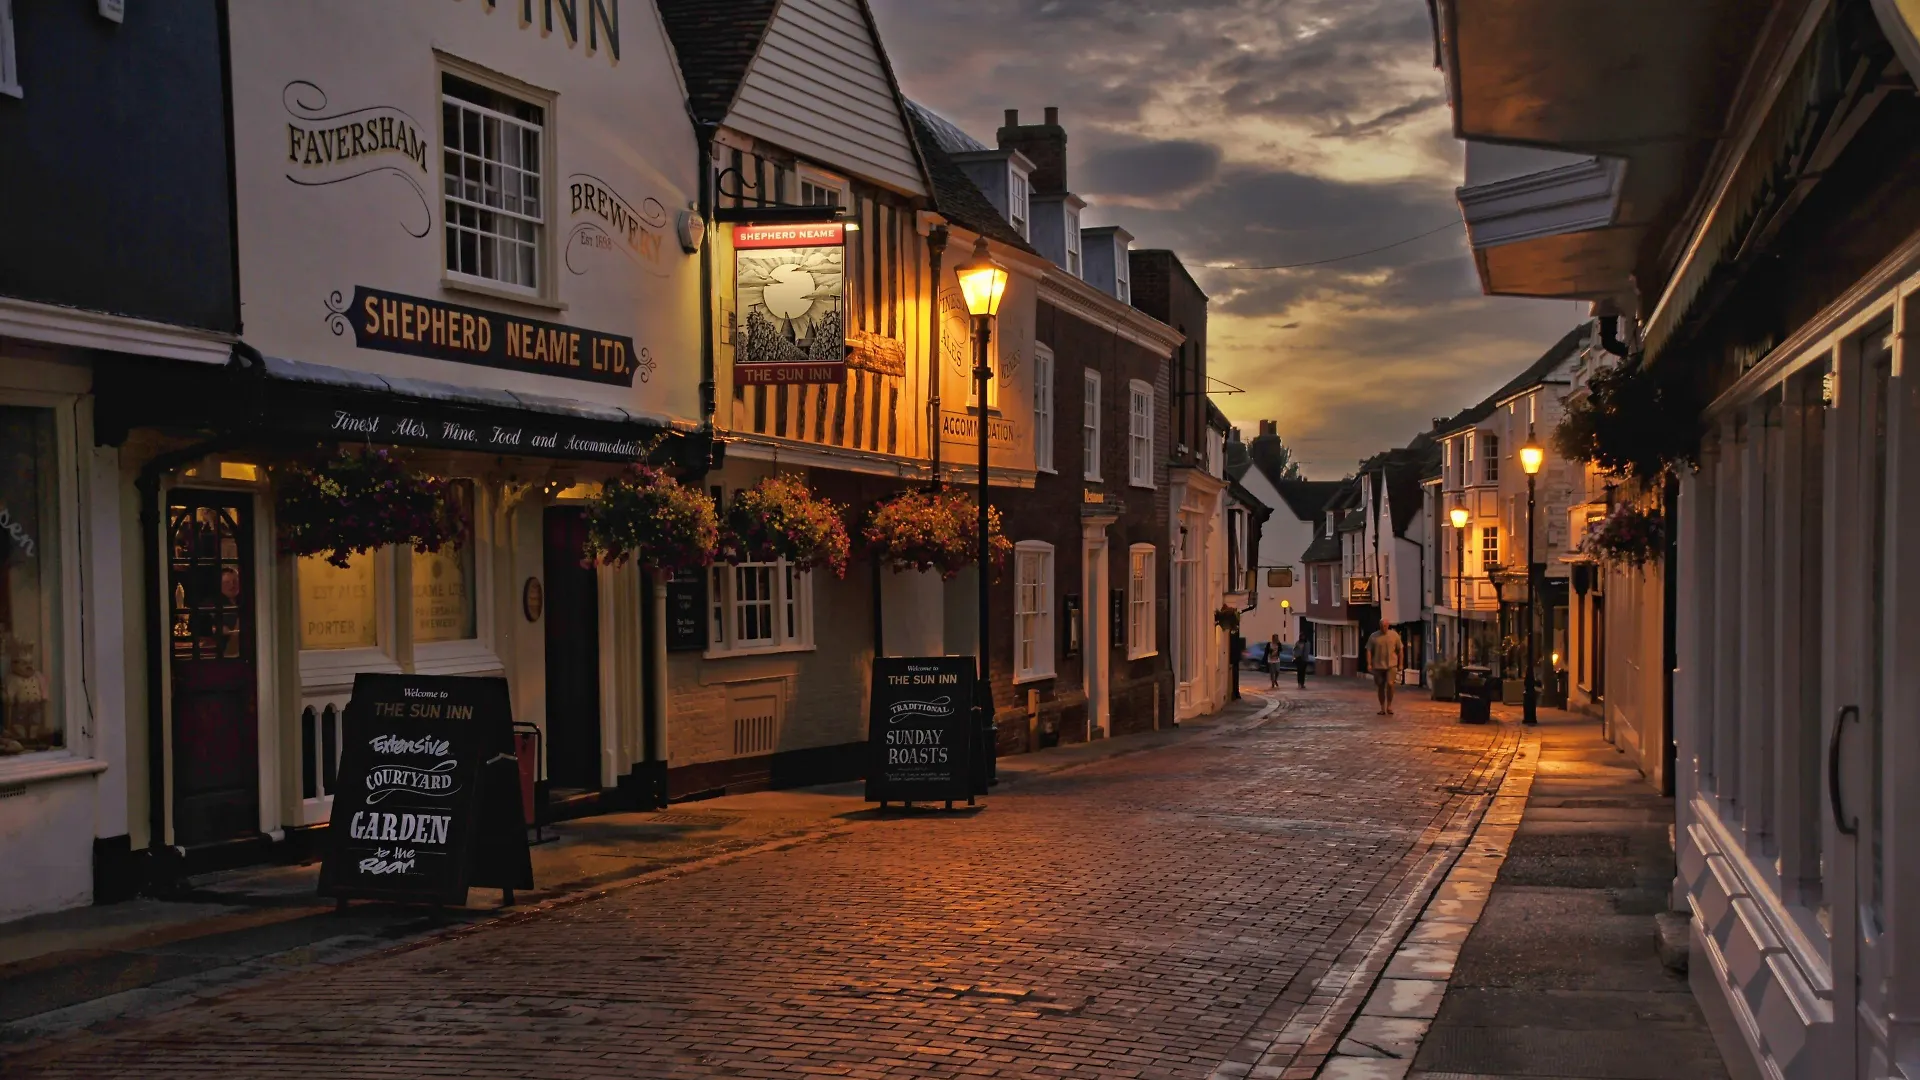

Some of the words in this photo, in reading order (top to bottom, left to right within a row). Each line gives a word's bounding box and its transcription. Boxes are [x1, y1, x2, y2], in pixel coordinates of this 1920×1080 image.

[288, 117, 428, 173] FAVERSHAM
[571, 183, 663, 265] BREWERY
[740, 231, 796, 241] SHEPHERD
[799, 229, 835, 239] NEAME
[364, 295, 491, 352] SHEPHERD
[507, 322, 581, 367] NEAME
[592, 337, 630, 375] LTD.
[941, 329, 962, 367] ALES
[745, 369, 772, 381] THE
[776, 368, 803, 381] SUN
[809, 368, 832, 380] INN
[331, 410, 379, 433] Finest
[488, 425, 521, 446] Food
[531, 432, 558, 449] and
[308, 619, 356, 636] PORTER
[888, 675, 910, 685] THE
[913, 674, 935, 684] SUN
[939, 674, 957, 684] INN
[404, 688, 438, 698] Welcome
[440, 690, 449, 698] to
[374, 702, 404, 717] THE
[410, 703, 441, 719] SUN
[446, 705, 473, 720] INN
[890, 703, 950, 714] TRADITIONAL
[886, 729, 944, 745] SUNDAY
[888, 747, 948, 765] ROASTS
[366, 769, 451, 790] COURTYARD
[350, 810, 451, 844] GARDEN
[374, 847, 391, 858] to
[393, 847, 416, 859] the
[359, 857, 415, 876] Rear
